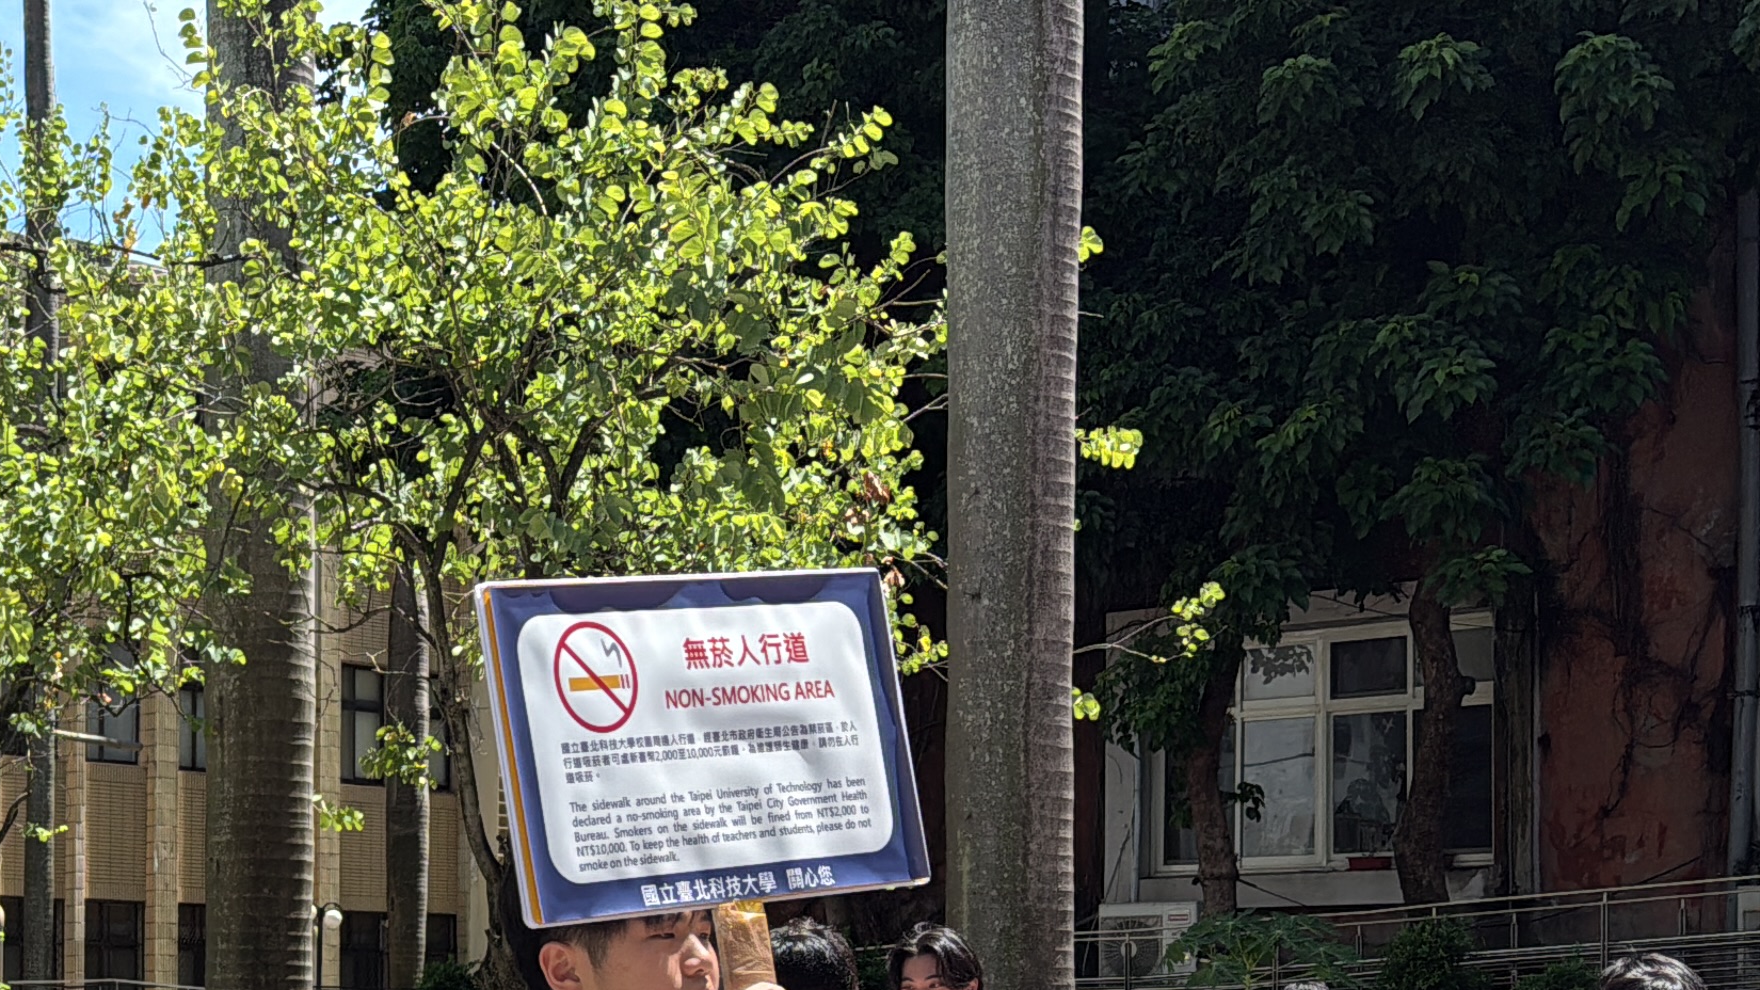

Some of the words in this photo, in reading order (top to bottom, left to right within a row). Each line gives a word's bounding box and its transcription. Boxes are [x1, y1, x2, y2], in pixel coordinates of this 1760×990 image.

[683, 632, 809, 670] 無菸人行道
[665, 682, 790, 709] NON-SMOKING
[794, 680, 835, 700] AREA
[569, 801, 587, 813] The
[592, 797, 630, 810] sidewalk
[636, 793, 666, 807] around
[671, 792, 685, 803] the
[688, 789, 712, 803] Taipei
[716, 786, 759, 800] University
[764, 783, 772, 795] of
[776, 781, 823, 794] Technology
[827, 779, 842, 788] has
[846, 776, 865, 787] been
[572, 814, 611, 827] declared
[616, 814, 622, 823] a
[626, 808, 678, 821] no-smoking
[683, 807, 701, 817] area
[704, 805, 715, 817] by
[719, 803, 732, 813] the
[736, 800, 762, 812] Taipei
[767, 798, 783, 810] City
[788, 794, 838, 806] Government
[841, 790, 867, 801] Health
[574, 832, 609, 843] Bureau.
[614, 825, 652, 838] Smokers
[657, 825, 669, 833] on
[673, 821, 687, 832] the
[692, 818, 727, 830] sidewalk
[732, 816, 746, 826] will
[751, 814, 762, 825] be
[768, 812, 790, 823] fined
[795, 809, 813, 820] from
[860, 805, 869, 814] to
[630, 841, 640, 851] To
[643, 840, 663, 852] keep
[666, 837, 680, 847] the
[682, 833, 709, 846] health
[711, 832, 720, 843] of
[722, 830, 756, 842] teachers
[759, 827, 776, 838] and
[817, 821, 843, 835] please
[845, 819, 855, 829] do
[858, 818, 871, 828] not
[579, 859, 608, 872] smoke
[610, 859, 622, 868] on
[624, 856, 638, 866] the
[640, 871, 778, 907] 國立臺北科技大學
[786, 865, 836, 890] 關心您
